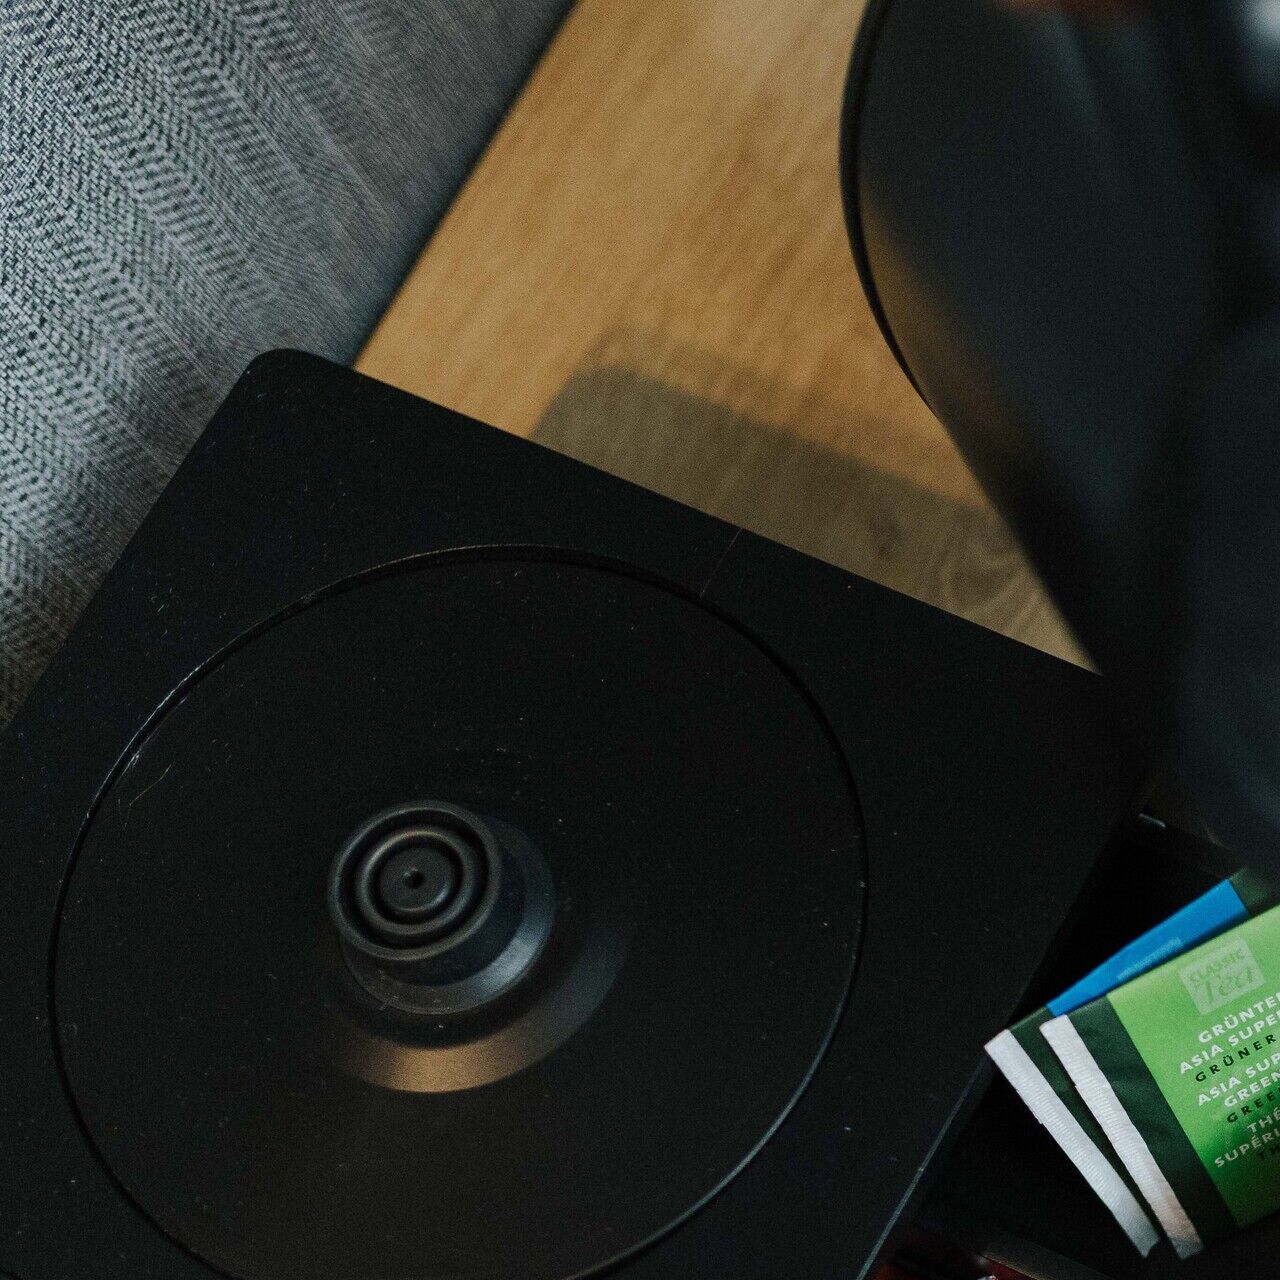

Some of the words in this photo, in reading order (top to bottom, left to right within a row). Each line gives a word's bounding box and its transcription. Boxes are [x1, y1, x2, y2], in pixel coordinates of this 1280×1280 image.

[1177, 1042, 1225, 1075] ASIA
[1194, 1032, 1278, 1083] GRÜNER
[1195, 1074, 1242, 1106] ASIA
